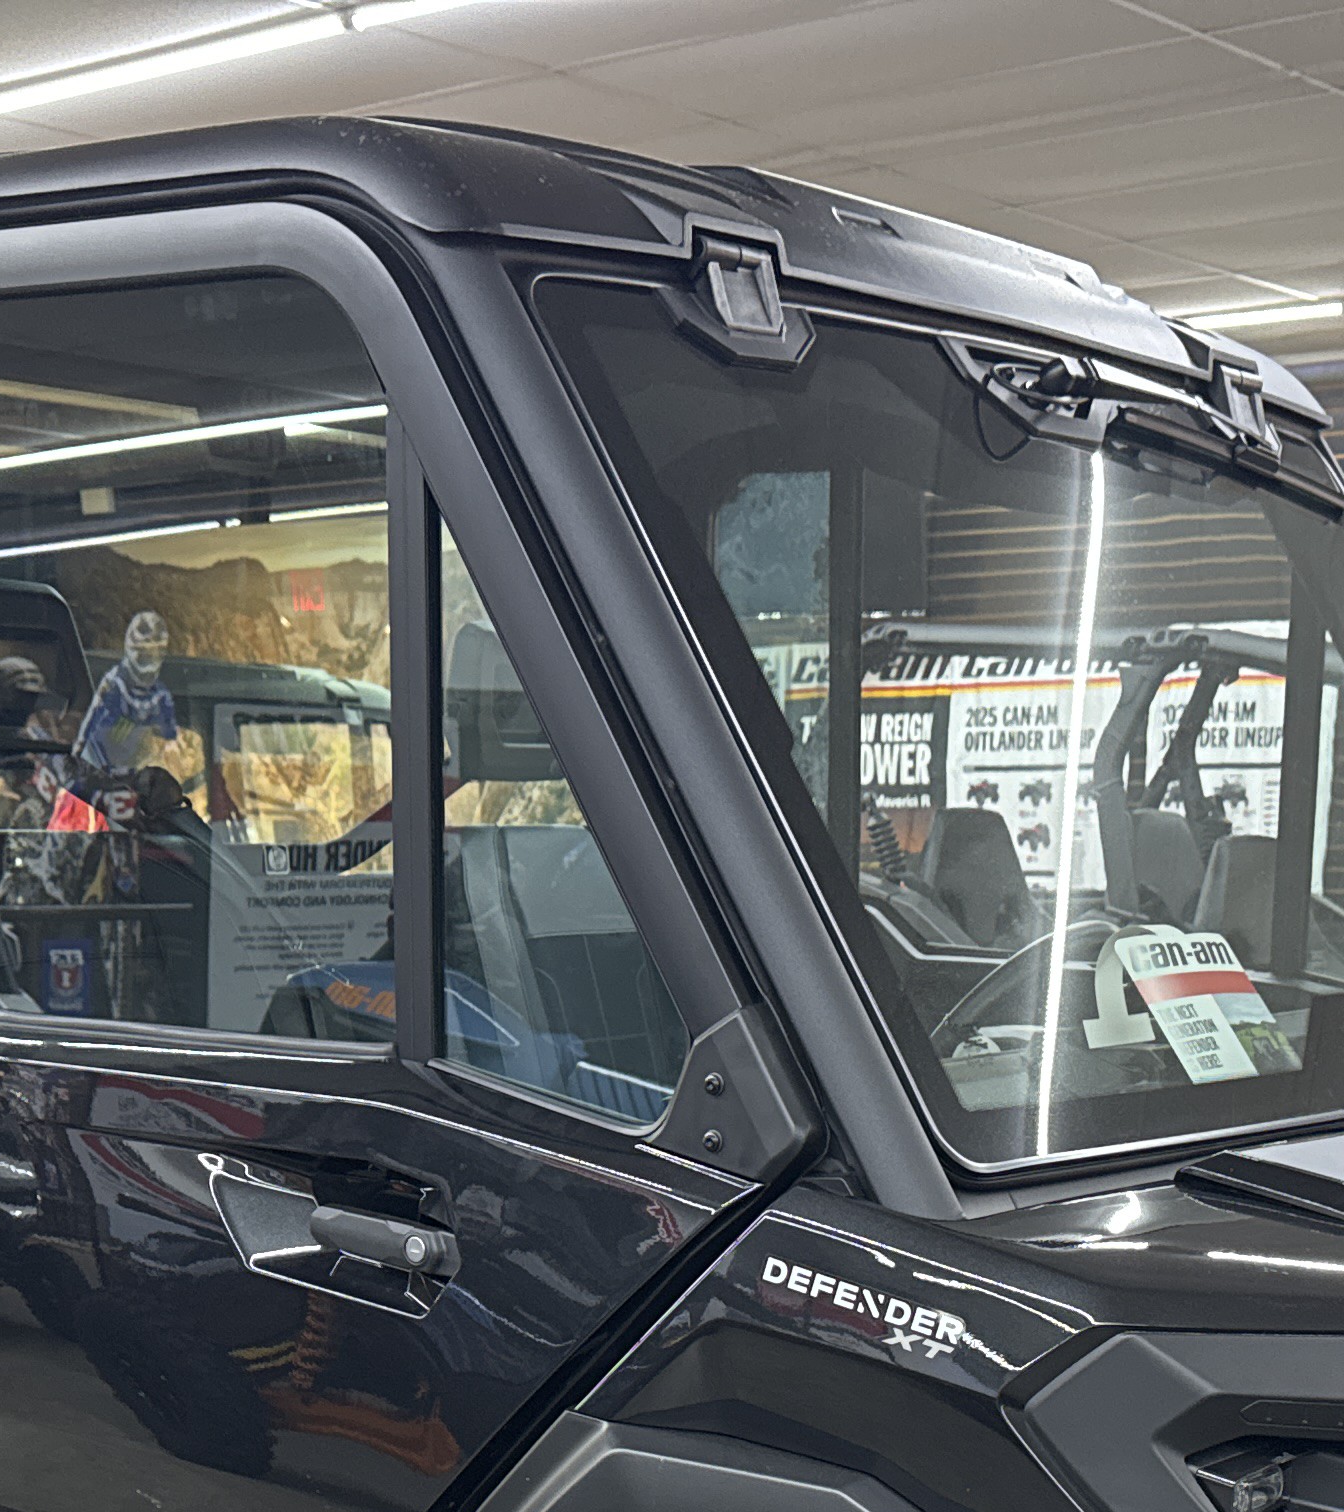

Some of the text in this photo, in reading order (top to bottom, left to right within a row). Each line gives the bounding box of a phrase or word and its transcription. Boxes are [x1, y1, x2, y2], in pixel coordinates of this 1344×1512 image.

[881, 712, 935, 743] REIGN
[1049, 727, 1096, 750] LINUP
[1128, 940, 1235, 973] can-am
[762, 1256, 966, 1345] DEFENDER
[881, 1327, 954, 1359] XT
